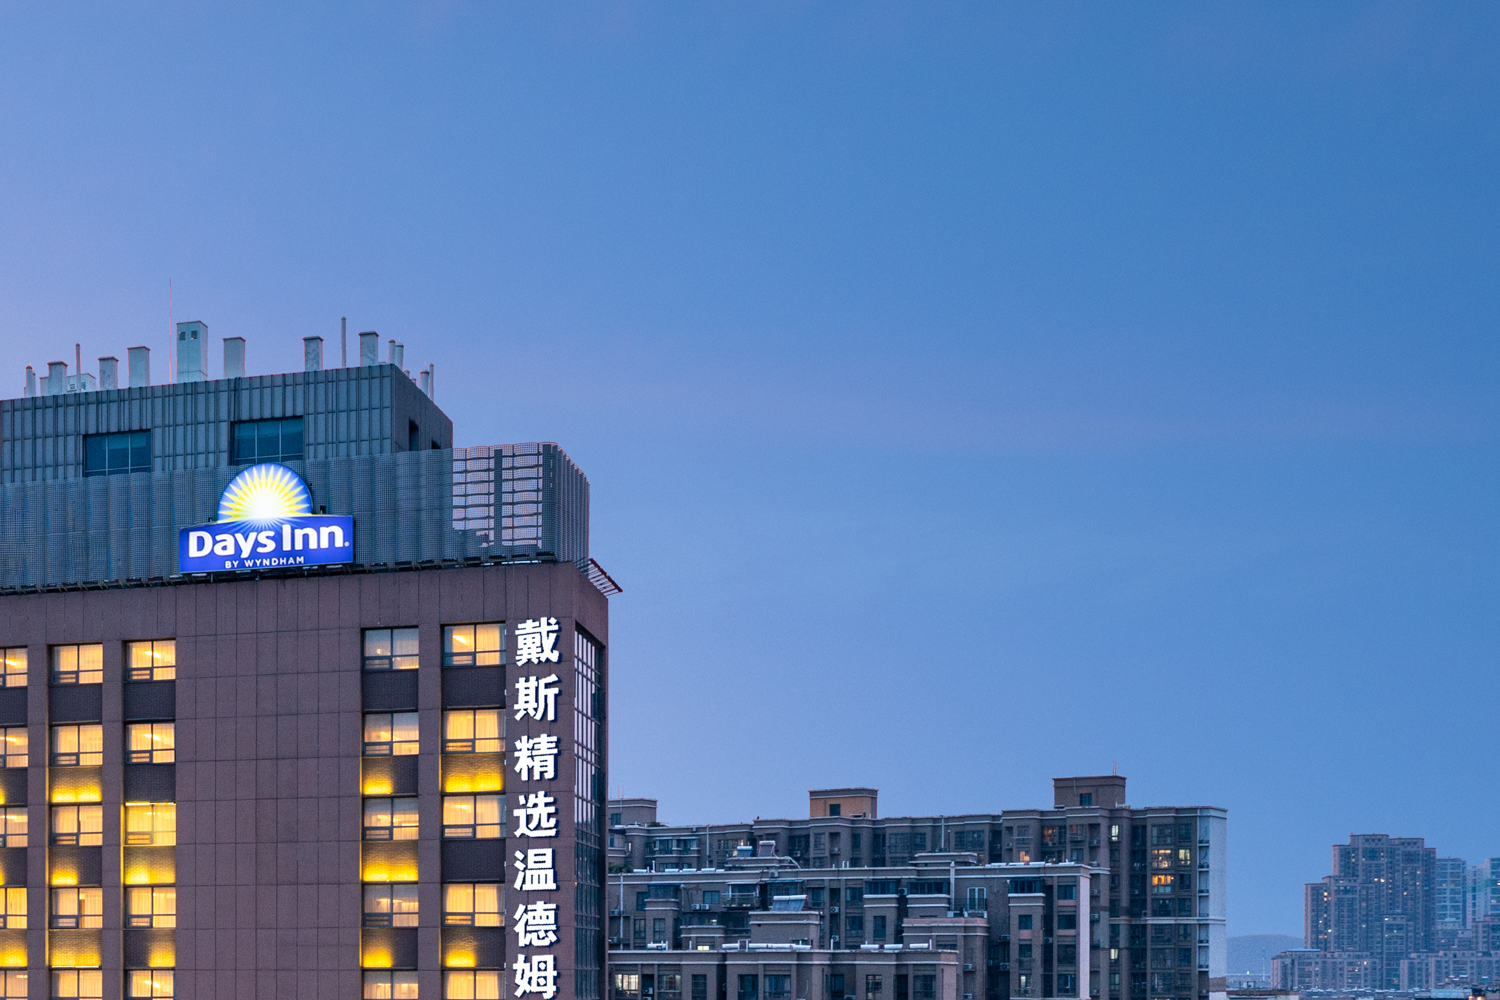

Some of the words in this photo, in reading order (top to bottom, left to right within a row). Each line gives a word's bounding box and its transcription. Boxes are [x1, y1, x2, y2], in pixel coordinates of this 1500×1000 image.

[188, 530, 277, 559] Days
[282, 523, 344, 552] Inn
[224, 560, 239, 569] BY
[244, 555, 305, 568] WYNDHAM
